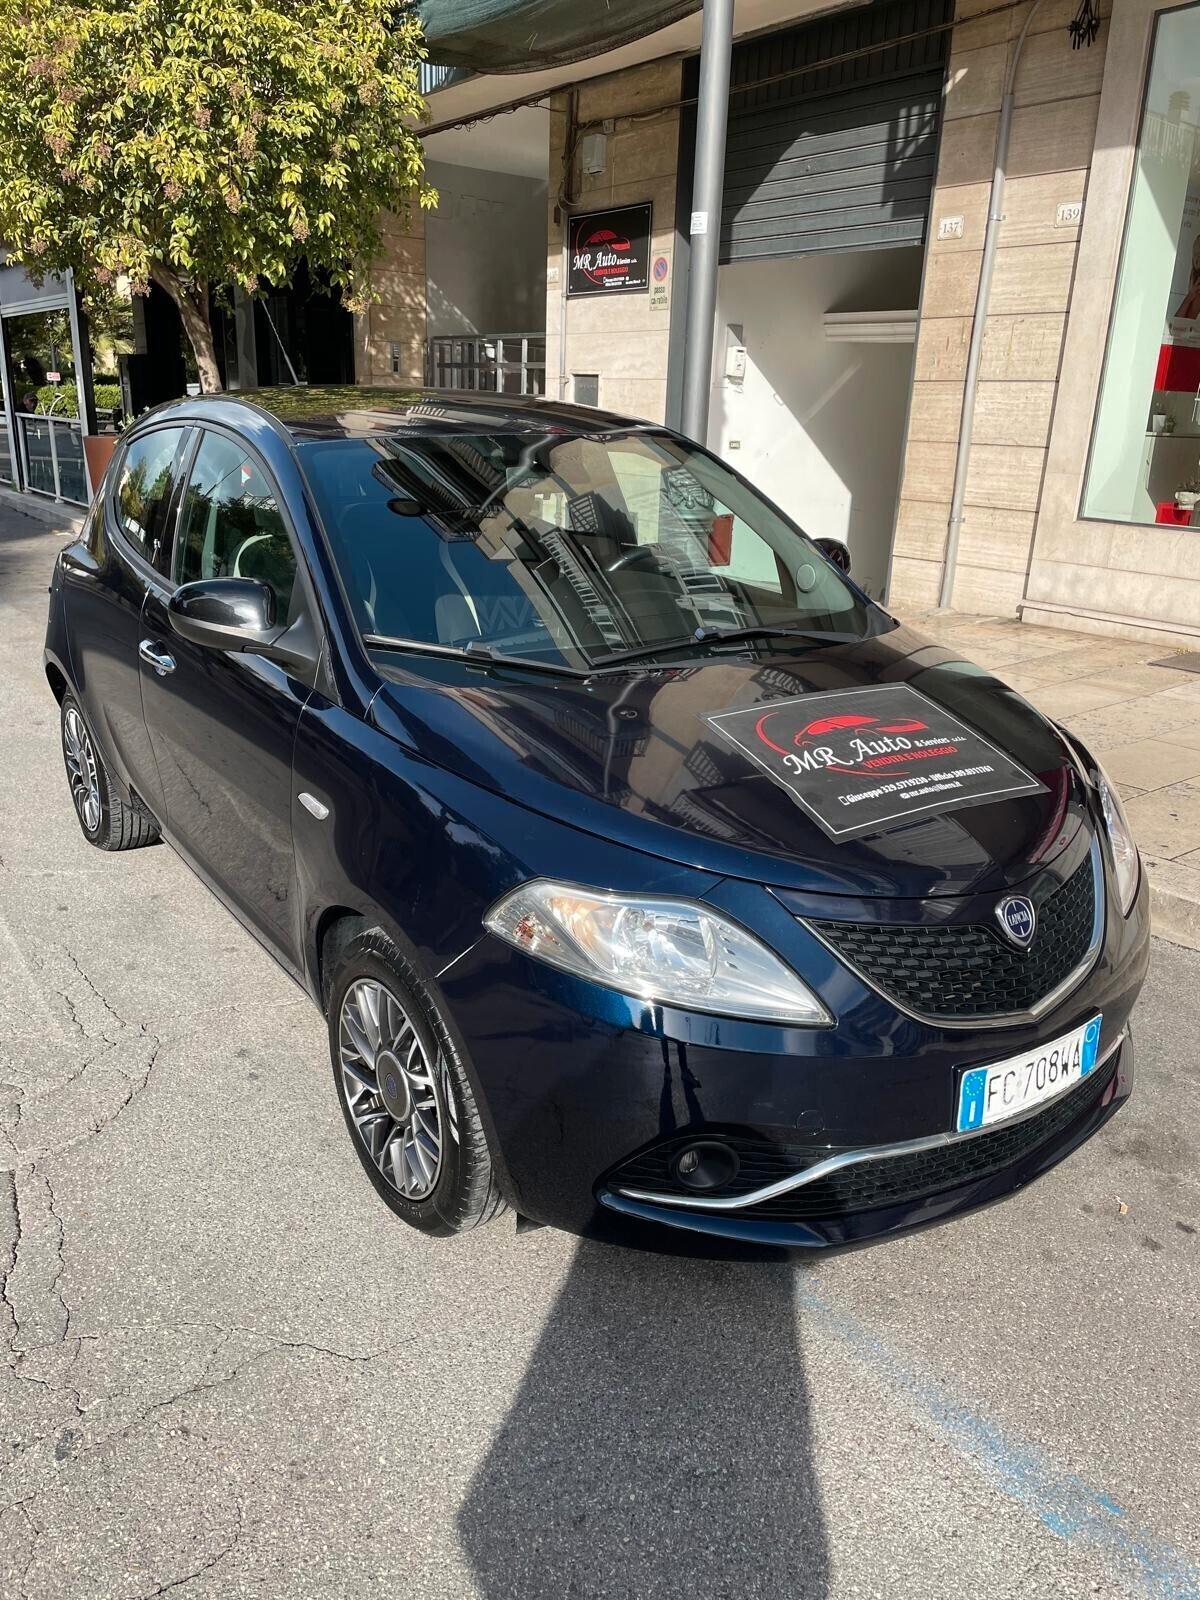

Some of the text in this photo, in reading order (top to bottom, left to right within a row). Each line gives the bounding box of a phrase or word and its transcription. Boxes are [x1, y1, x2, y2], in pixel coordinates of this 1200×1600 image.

[1060, 208, 1080, 221] 139
[942, 222, 960, 234] 137
[573, 254, 593, 271] MR
[593, 252, 617, 269] Auto
[783, 746, 854, 775] MR
[850, 736, 912, 762] Auto
[922, 737, 951, 747] Services
[863, 754, 905, 769] VENDITA
[913, 746, 959, 760] NOLEGGIO
[846, 788, 884, 804] Giuseppe
[1007, 910, 1029, 926] LANCIA
